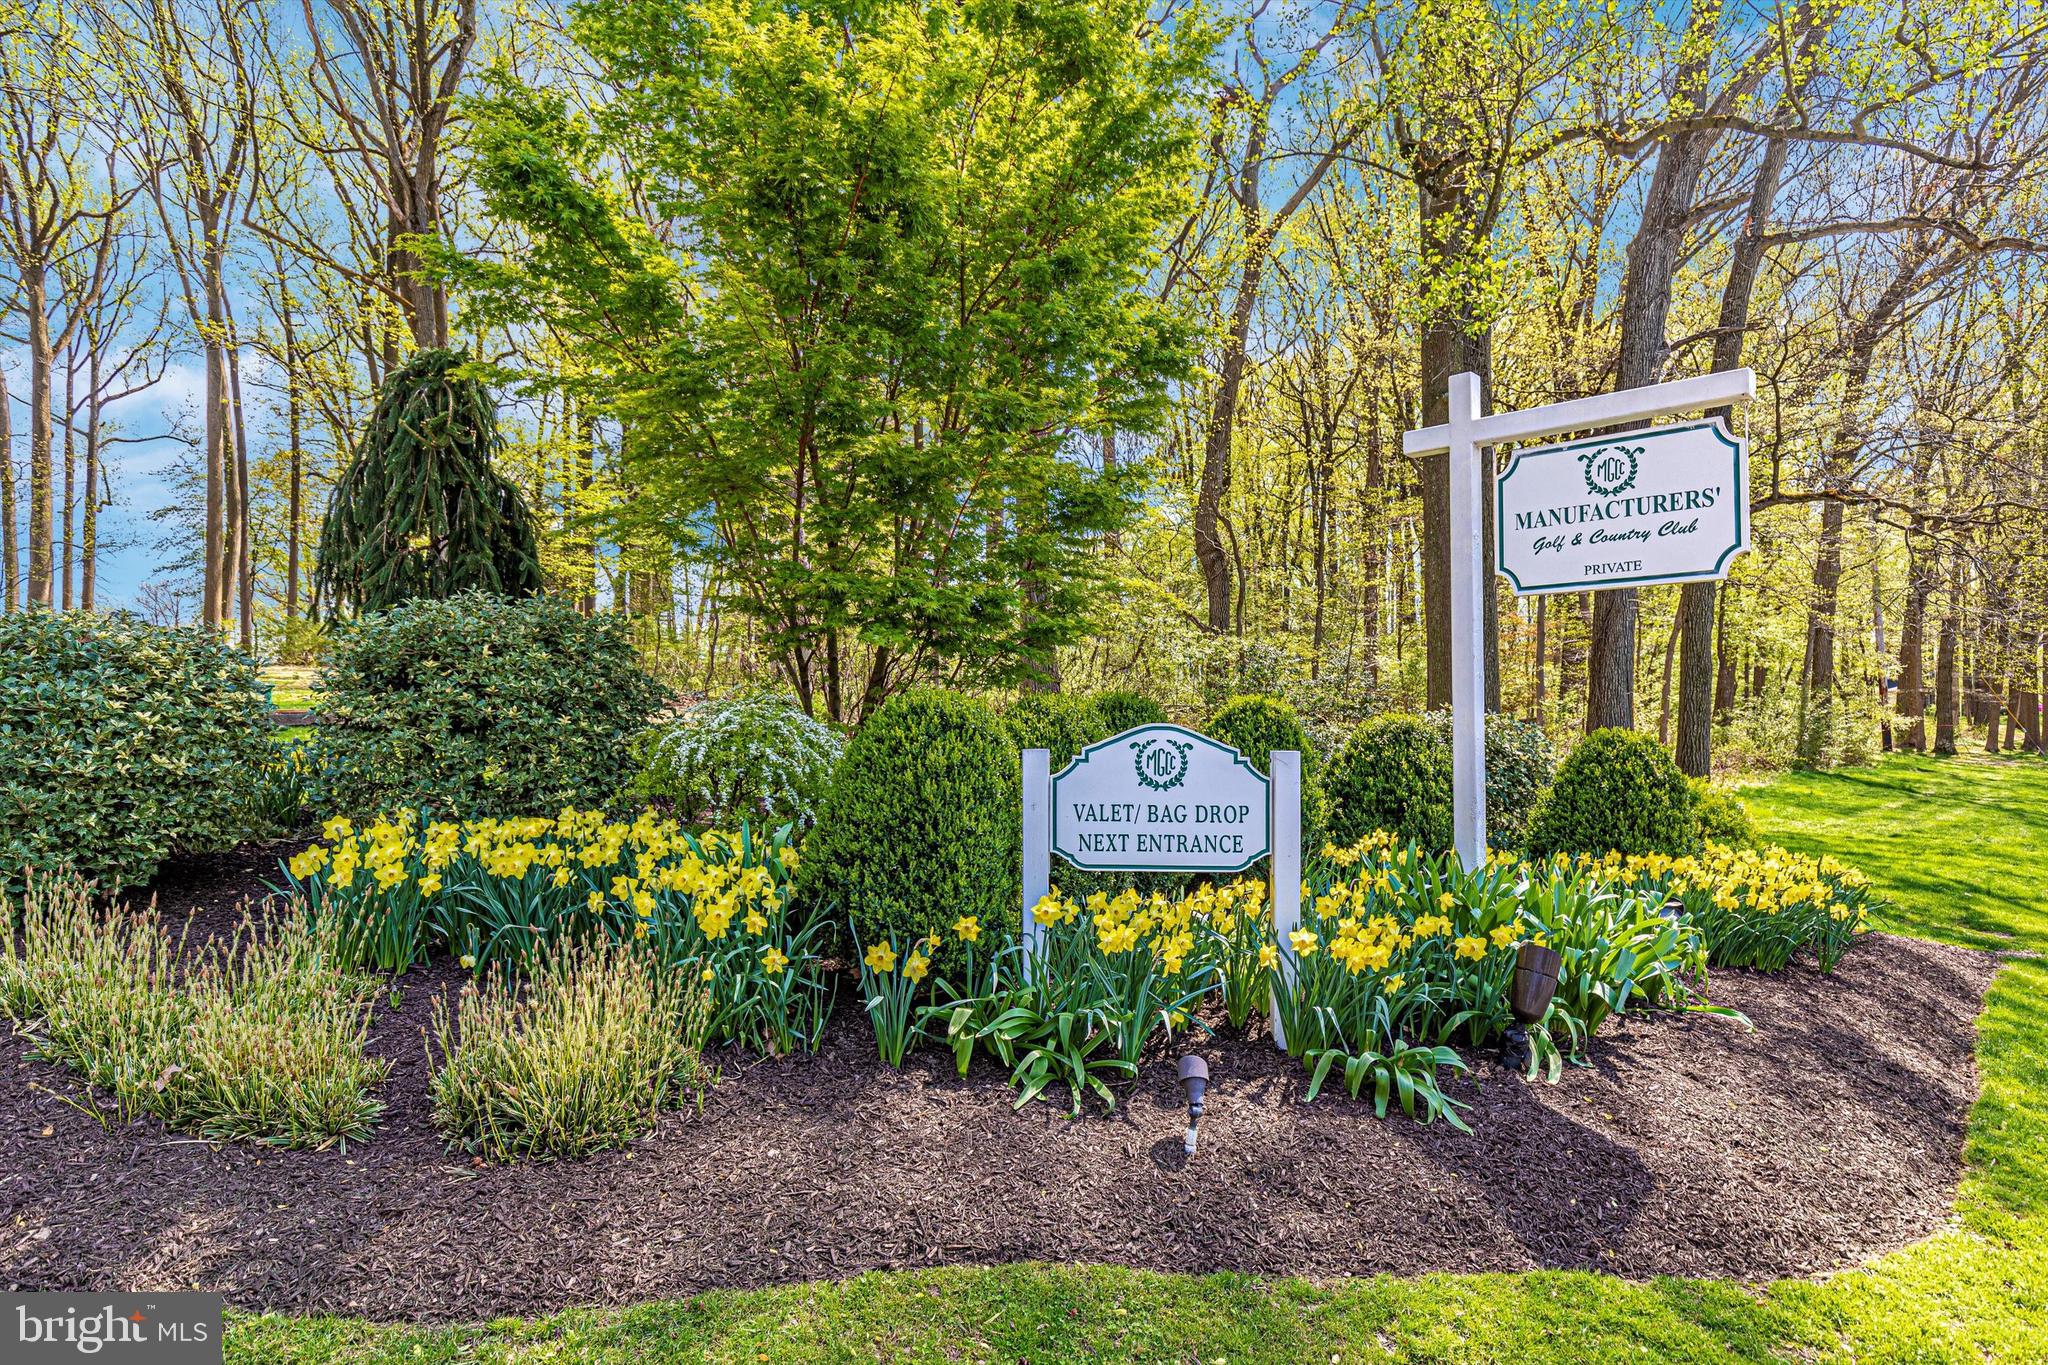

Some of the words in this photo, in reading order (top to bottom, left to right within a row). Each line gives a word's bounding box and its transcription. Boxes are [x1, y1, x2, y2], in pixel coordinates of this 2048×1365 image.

[1515, 487, 1721, 530] MANUFACTURERS'
[1533, 535, 1565, 555] Golf
[1571, 532, 1582, 545] &
[1589, 528, 1651, 545] Country
[1658, 518, 1699, 537] Club
[1584, 560, 1642, 576] PRIVATE
[1073, 803, 1141, 824] VALET/
[1148, 804, 1187, 823] BAG
[1195, 805, 1250, 824] DROP
[1078, 834, 1130, 852] NEXT
[1137, 834, 1244, 853] ENTRANCE
